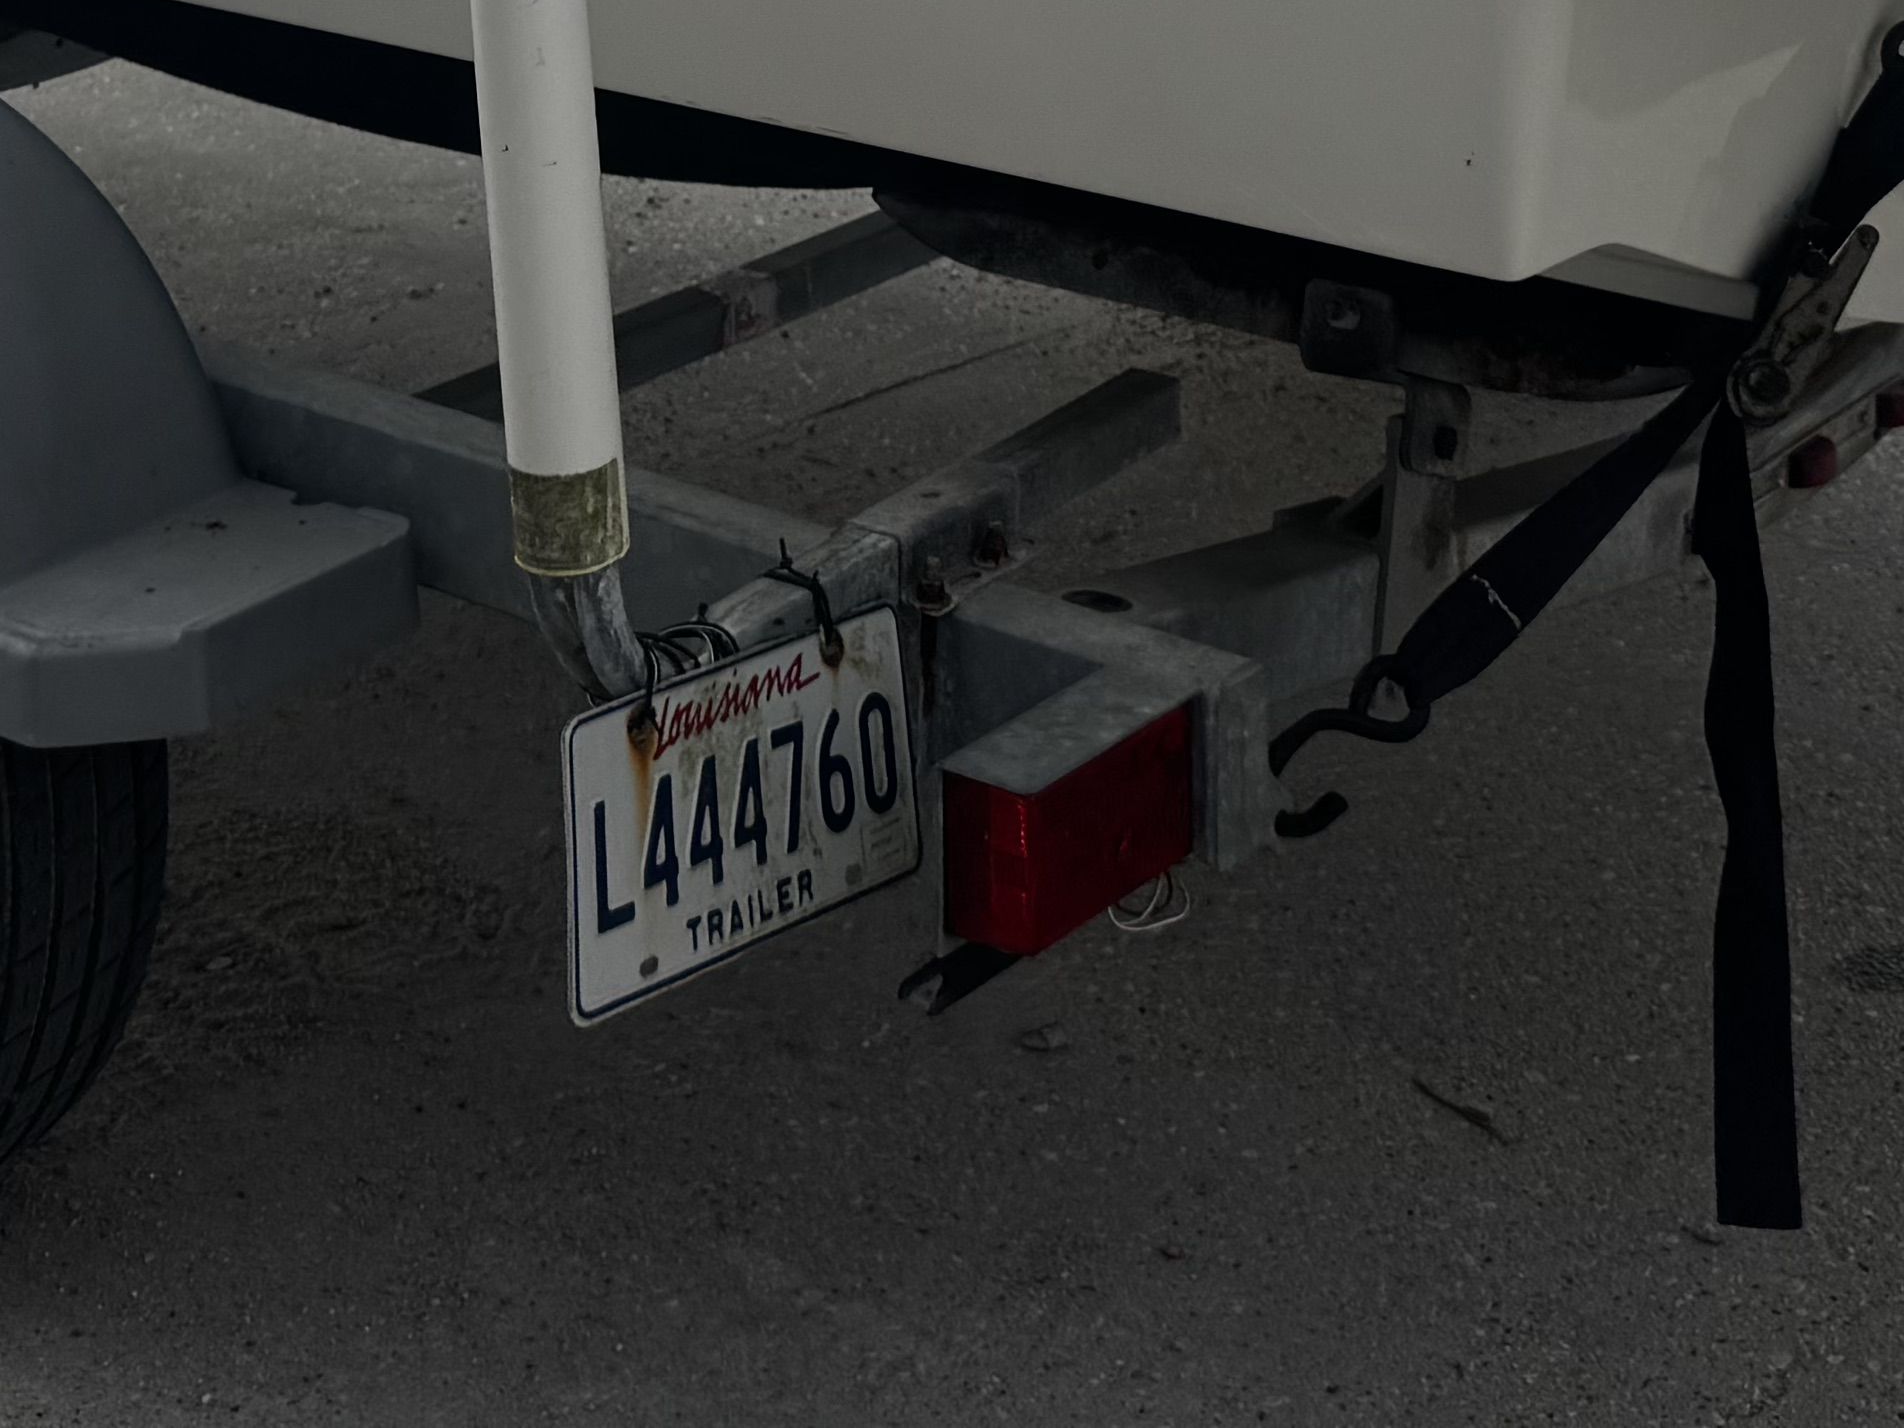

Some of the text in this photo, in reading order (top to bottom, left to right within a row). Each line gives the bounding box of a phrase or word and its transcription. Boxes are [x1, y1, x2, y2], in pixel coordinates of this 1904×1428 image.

[653, 653, 821, 760] Louisiana
[593, 691, 897, 934] L444760
[686, 869, 814, 952] TRAILER
